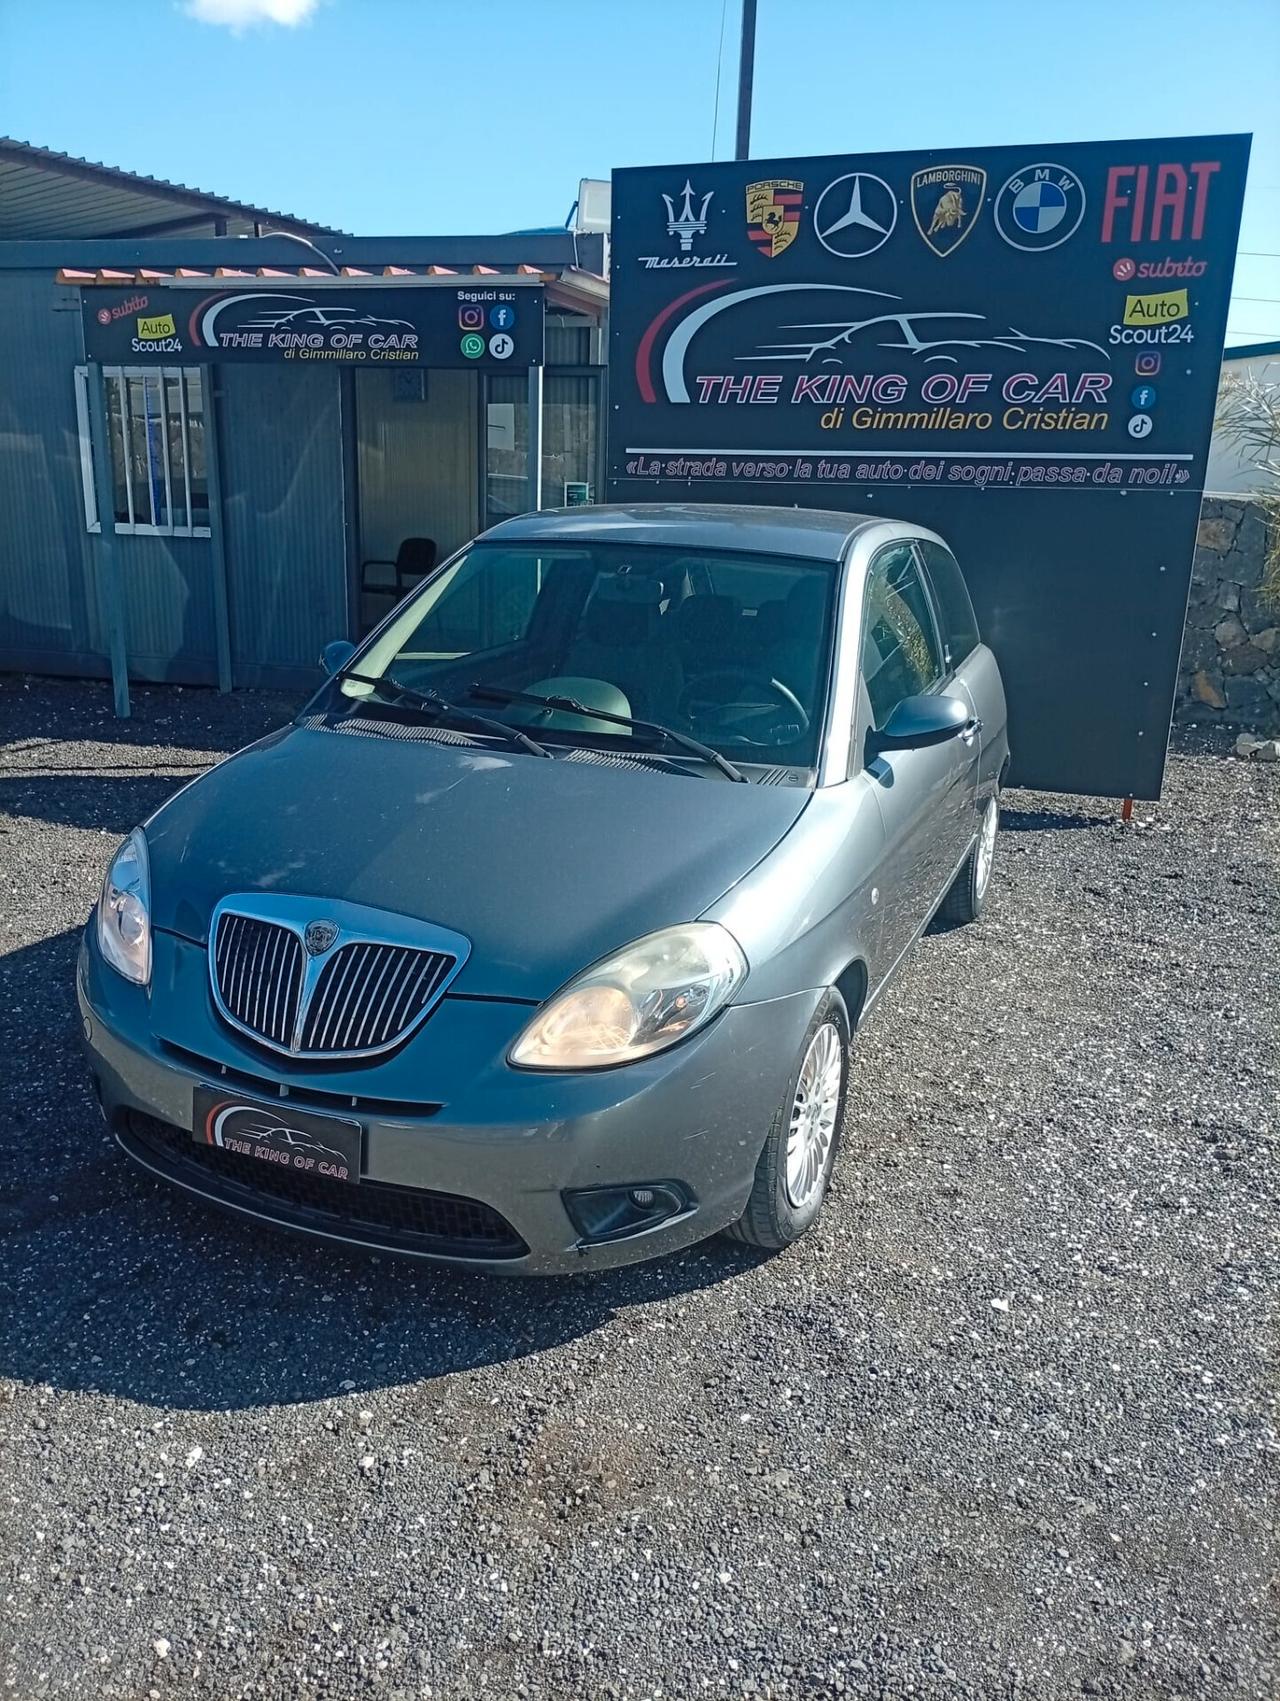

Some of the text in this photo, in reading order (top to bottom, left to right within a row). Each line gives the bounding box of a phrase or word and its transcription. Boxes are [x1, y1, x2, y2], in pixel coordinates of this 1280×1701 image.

[747, 181, 803, 192] PORSCHE
[916, 168, 983, 188] LAMBORGHINI
[1008, 168, 1075, 194] BMW
[1101, 161, 1221, 243] FIAT
[638, 254, 738, 269] Maserati
[1137, 256, 1208, 278] subito
[457, 291, 516, 302] Seguici su:
[111, 295, 149, 319] subito
[1129, 299, 1180, 318] Auto
[141, 321, 171, 334] Auto
[1108, 325, 1194, 344] Scout24
[131, 338, 183, 352] Scout24
[219, 333, 419, 349] THE KING OF CAR
[284, 348, 419, 360] di Gimmillaro Cristian
[696, 373, 1113, 404] THE KING OF CAR
[820, 407, 1109, 430] di Gimmillaro Cristian
[665, 457, 727, 478] strada
[732, 460, 789, 478] verso
[793, 459, 812, 479] la
[816, 460, 850, 479] tua
[855, 461, 903, 480] auto
[908, 461, 945, 480] dei
[948, 461, 1013, 487] sogni
[1015, 466, 1087, 486] passa
[1092, 463, 1123, 484] da
[224, 1137, 349, 1180] THE KING OF CAR
